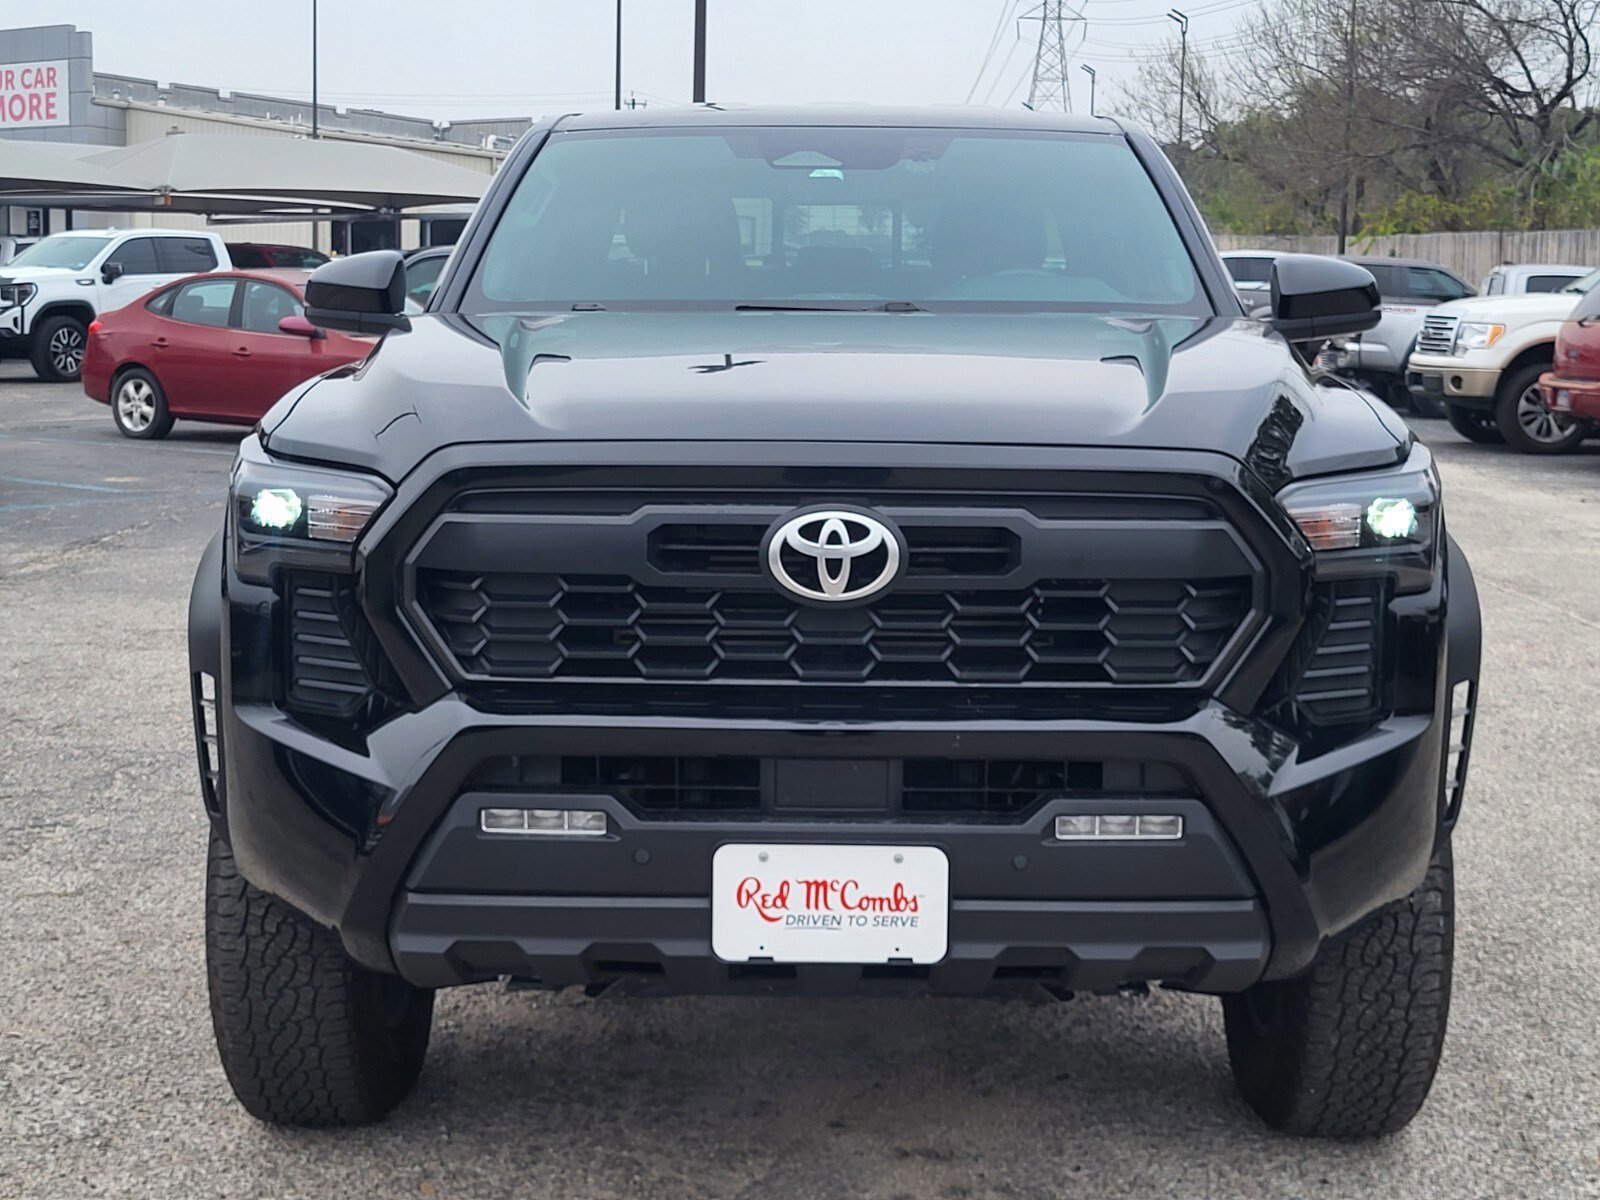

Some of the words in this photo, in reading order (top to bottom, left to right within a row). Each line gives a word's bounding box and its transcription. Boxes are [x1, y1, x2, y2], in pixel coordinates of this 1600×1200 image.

[21, 67, 57, 89] CAR
[736, 876, 790, 922] Red
[796, 879, 918, 913] McCombs
[785, 914, 842, 926] DRIVEN
[848, 915, 868, 927] TO
[872, 915, 919, 928] SERVE
